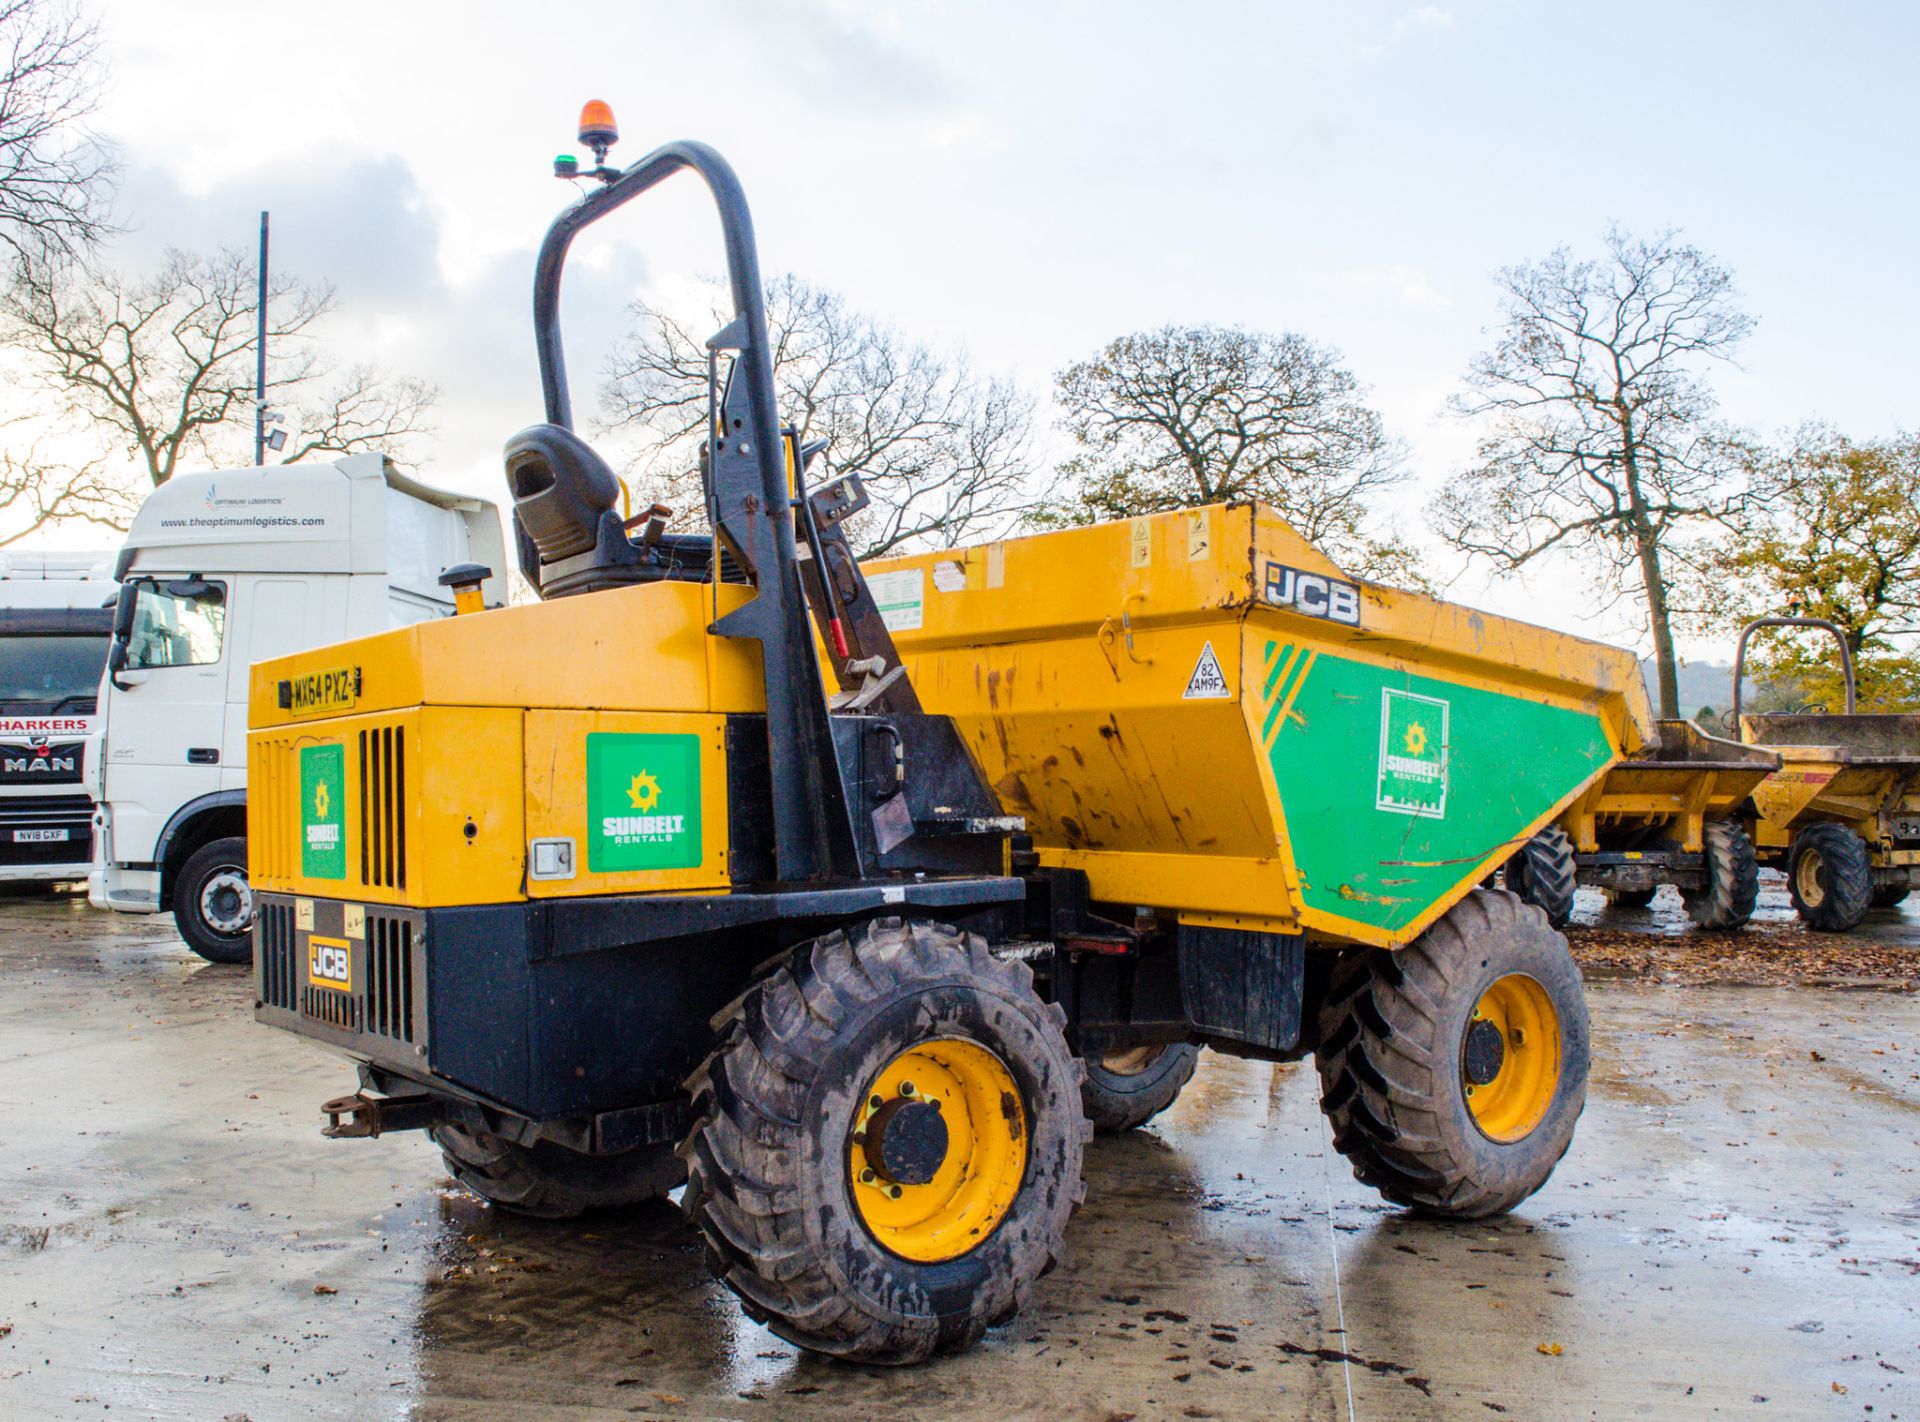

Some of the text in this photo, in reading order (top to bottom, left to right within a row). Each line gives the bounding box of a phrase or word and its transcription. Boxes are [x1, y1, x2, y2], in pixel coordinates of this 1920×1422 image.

[161, 516, 325, 529] www.theoptimumlogistics.com
[1267, 569, 1359, 623] JCB
[1201, 663, 1214, 677] 82
[295, 671, 349, 708] MX64 PXZ
[0, 719, 87, 730] HARKERS
[4, 757, 75, 772] MAN
[1386, 754, 1440, 778] SUNBELT
[1393, 771, 1433, 784] RENTALS
[307, 823, 340, 843] SUNBELT
[602, 815, 684, 836] SUNBELT
[20, 830, 63, 840] NV18 GXF
[615, 834, 673, 845] RENTALS
[311, 945, 348, 980] JCB
